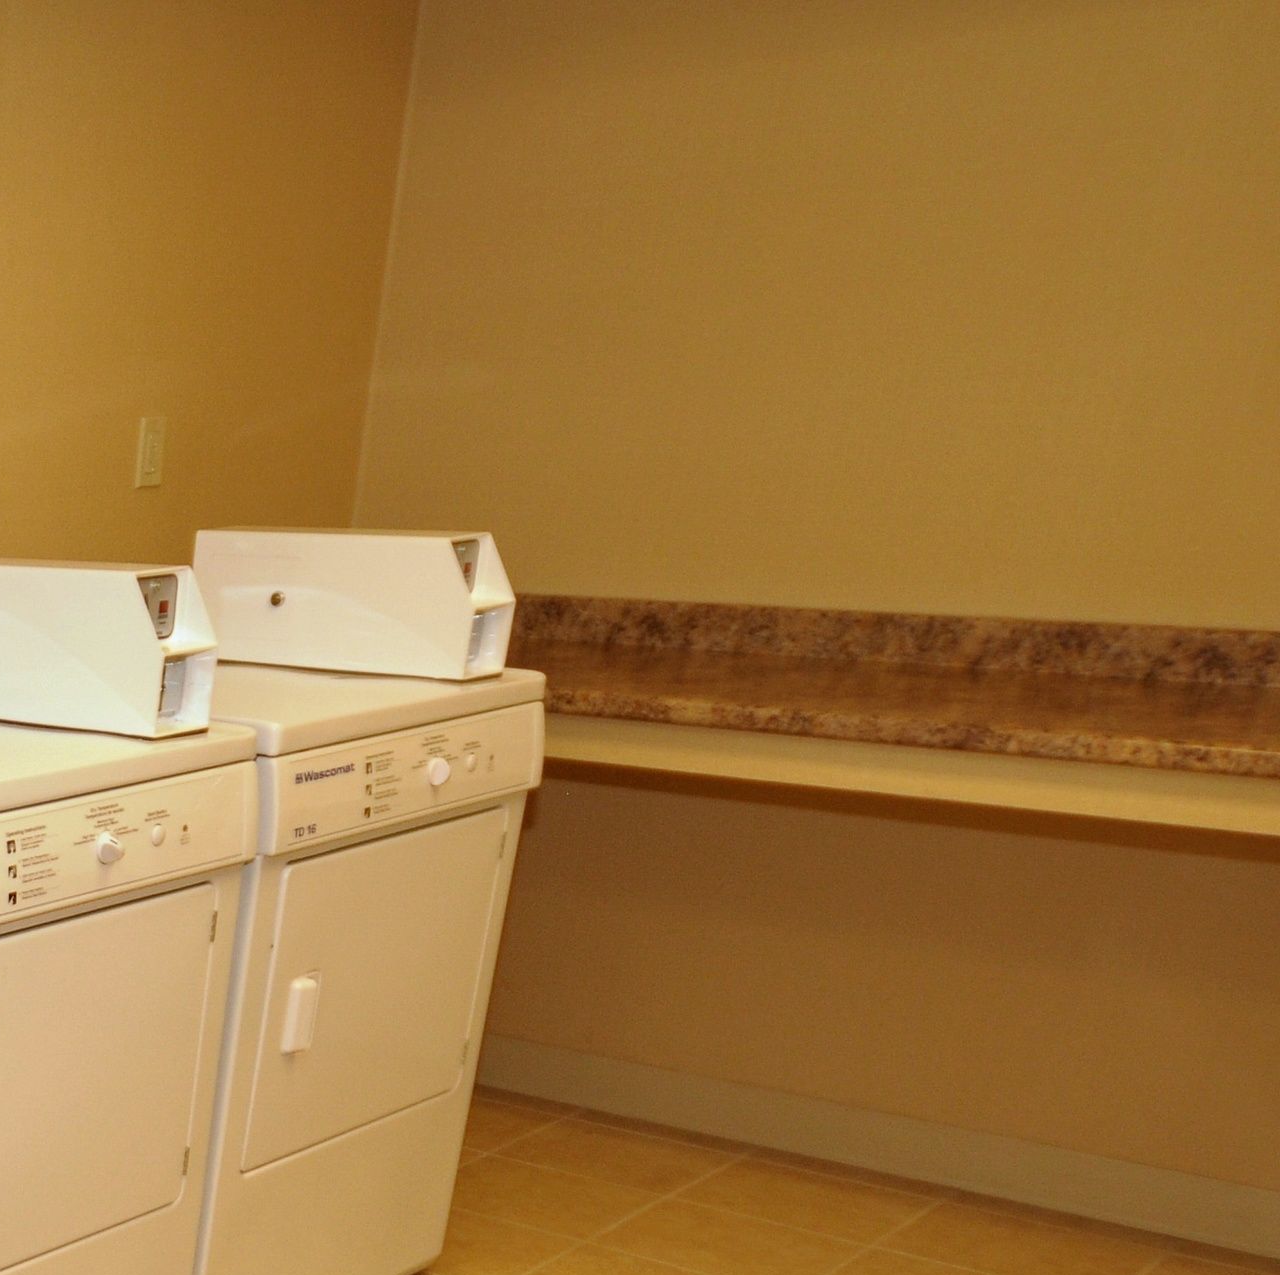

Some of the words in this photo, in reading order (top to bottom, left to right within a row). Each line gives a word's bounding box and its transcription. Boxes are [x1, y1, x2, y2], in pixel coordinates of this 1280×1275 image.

[304, 763, 355, 783] Wascomat
[294, 826, 305, 838] TD
[307, 824, 317, 835] 16
